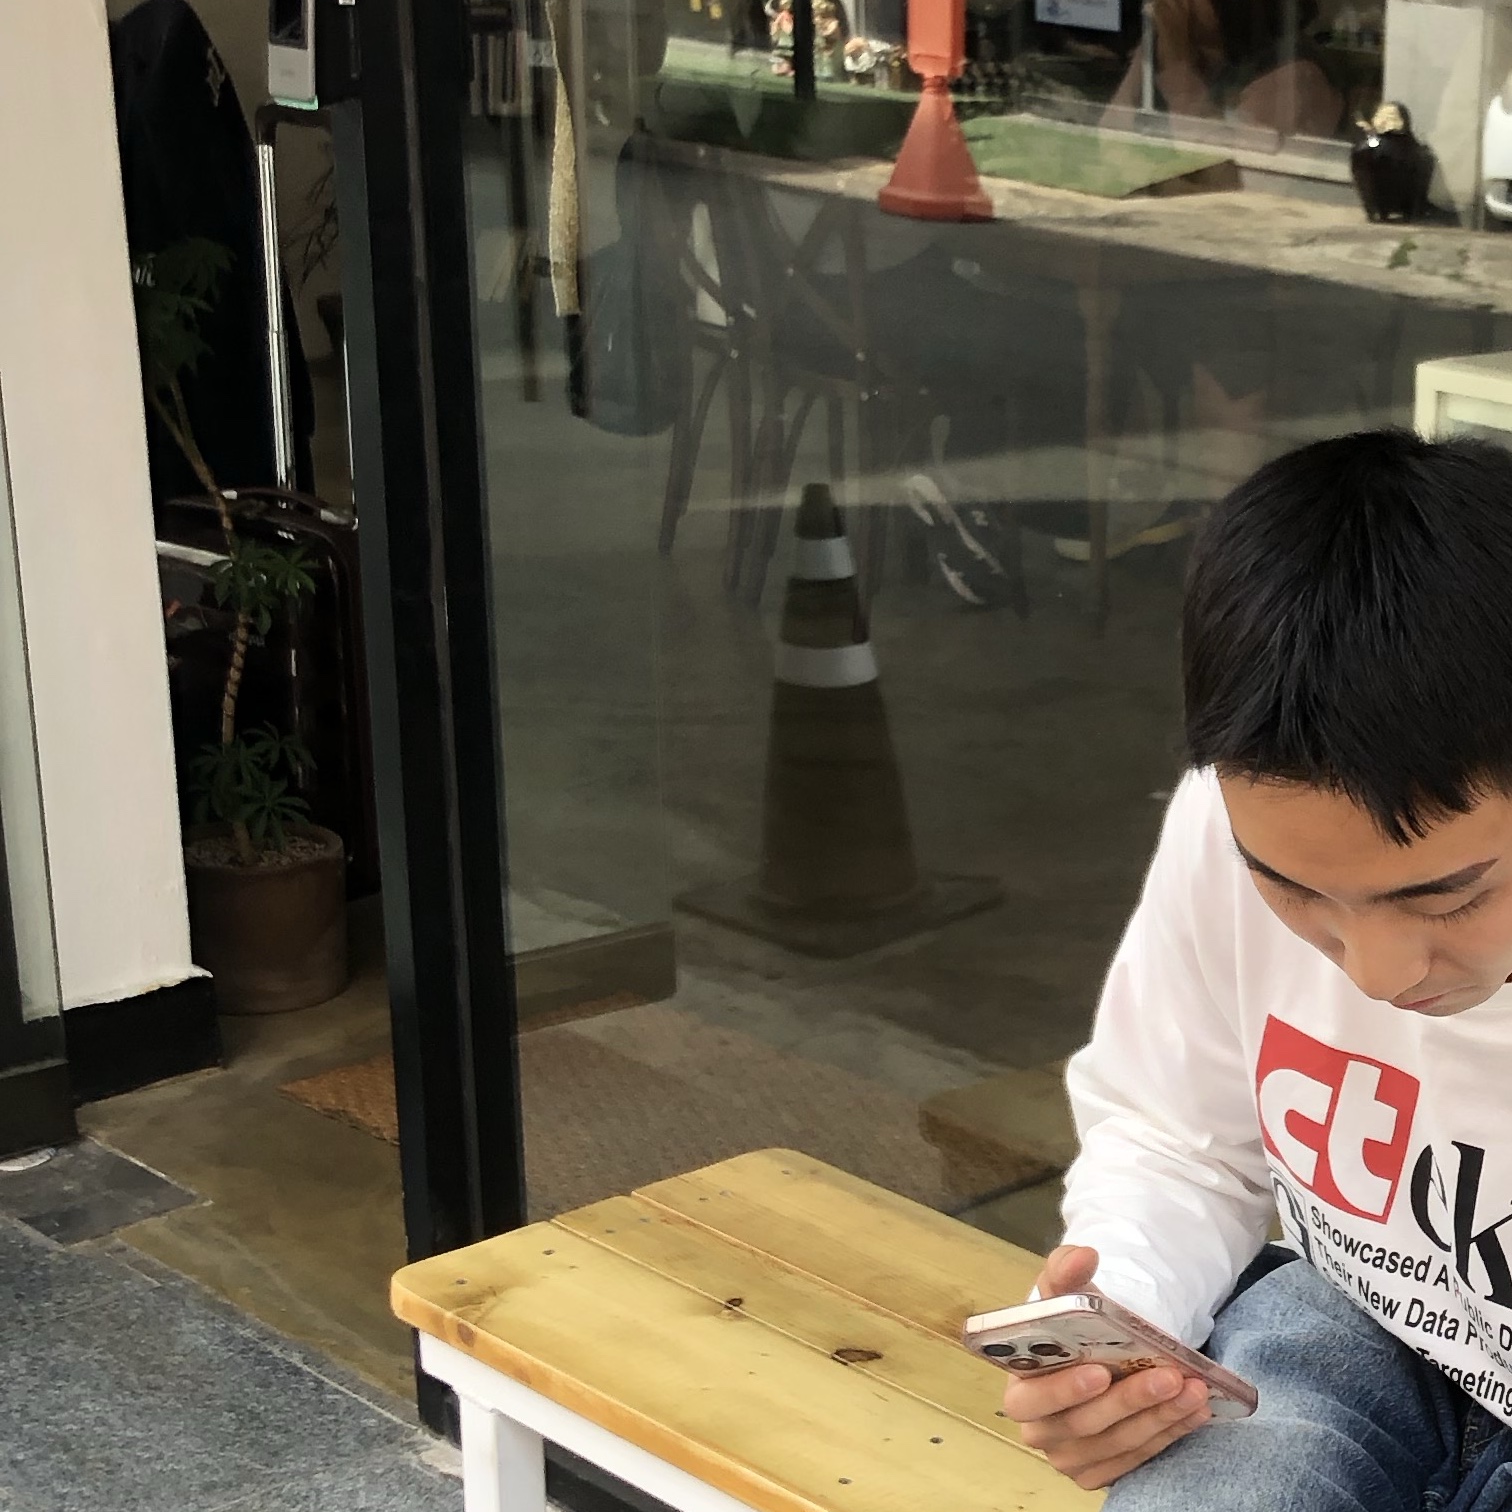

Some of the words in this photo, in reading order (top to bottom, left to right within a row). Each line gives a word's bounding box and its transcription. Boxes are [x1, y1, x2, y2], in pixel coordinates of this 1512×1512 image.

[1310, 1205, 1432, 1283] Showcased
[1432, 1264, 1450, 1292] A
[1313, 1235, 1353, 1288] Their
[1357, 1275, 1402, 1320] New
[1404, 1297, 1460, 1341] Data
